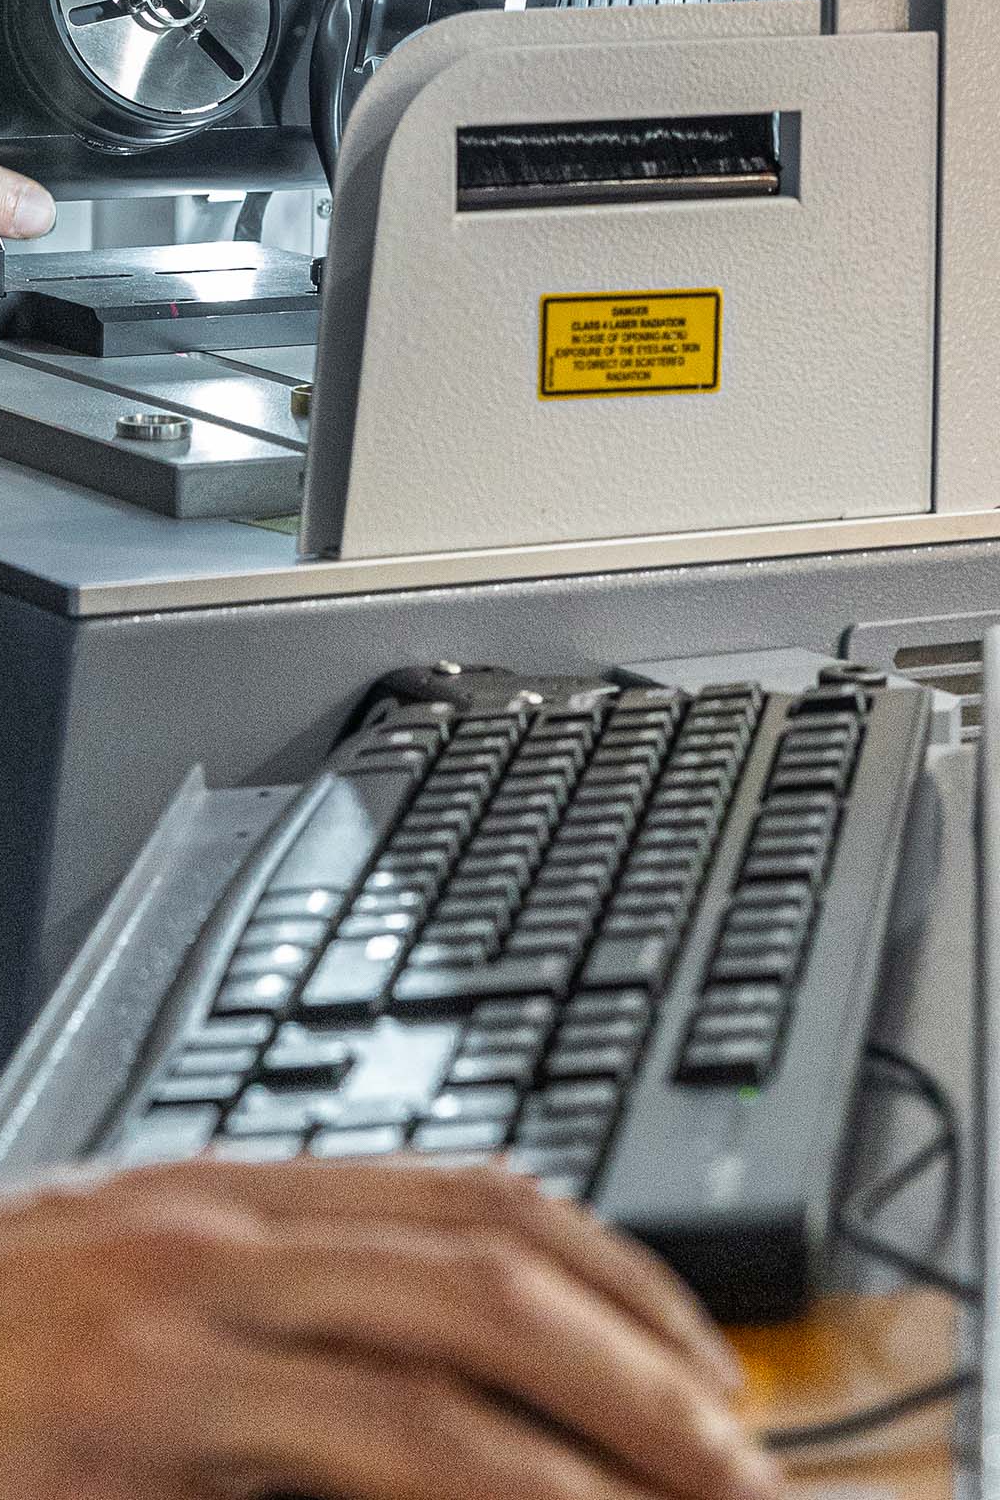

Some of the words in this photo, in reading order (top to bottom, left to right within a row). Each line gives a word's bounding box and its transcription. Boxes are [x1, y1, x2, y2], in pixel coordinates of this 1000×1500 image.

[571, 321, 600, 331] CLASS
[609, 319, 637, 330] LASER
[640, 318, 687, 328] RADIATION
[583, 333, 604, 343] CASE
[607, 333, 618, 343] OF
[619, 345, 633, 355] THE
[606, 371, 651, 381] RADIATION
